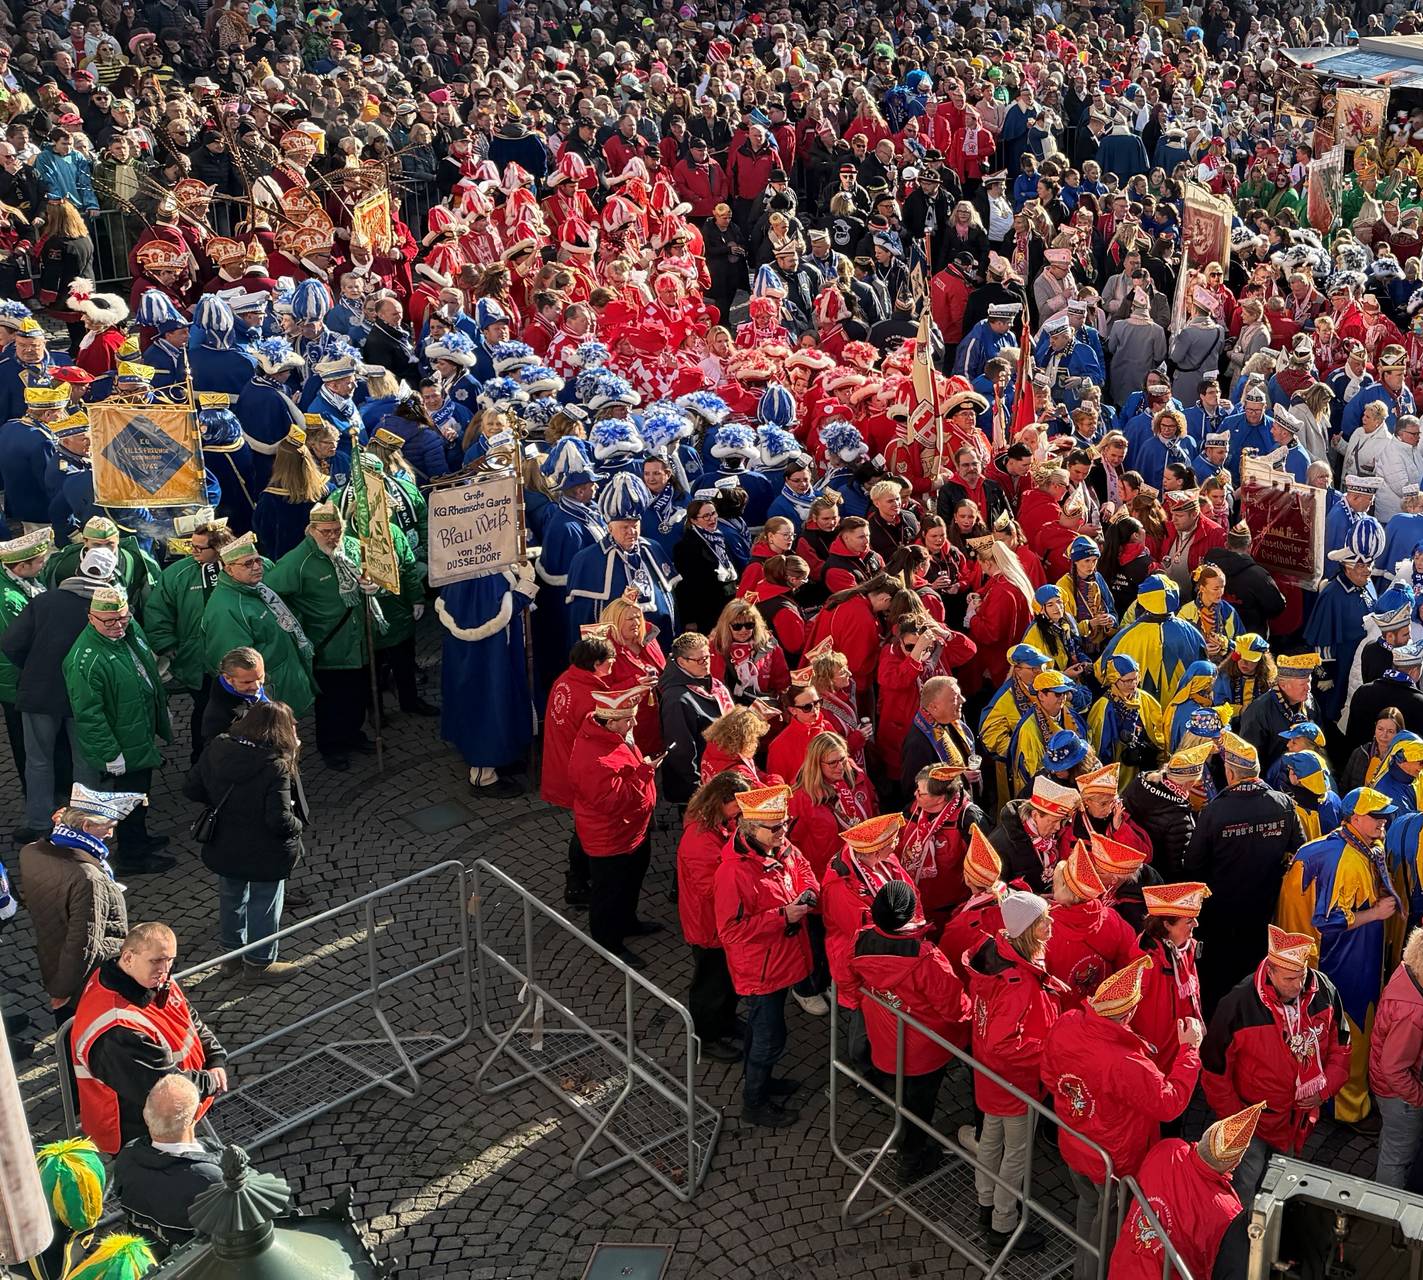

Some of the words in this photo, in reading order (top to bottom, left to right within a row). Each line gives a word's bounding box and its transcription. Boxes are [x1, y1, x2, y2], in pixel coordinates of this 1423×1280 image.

[463, 490, 485, 502] Große
[486, 496, 512, 508] Garde
[436, 526, 473, 549] Blau
[457, 549, 473, 557] von
[474, 542, 493, 555] 1968
